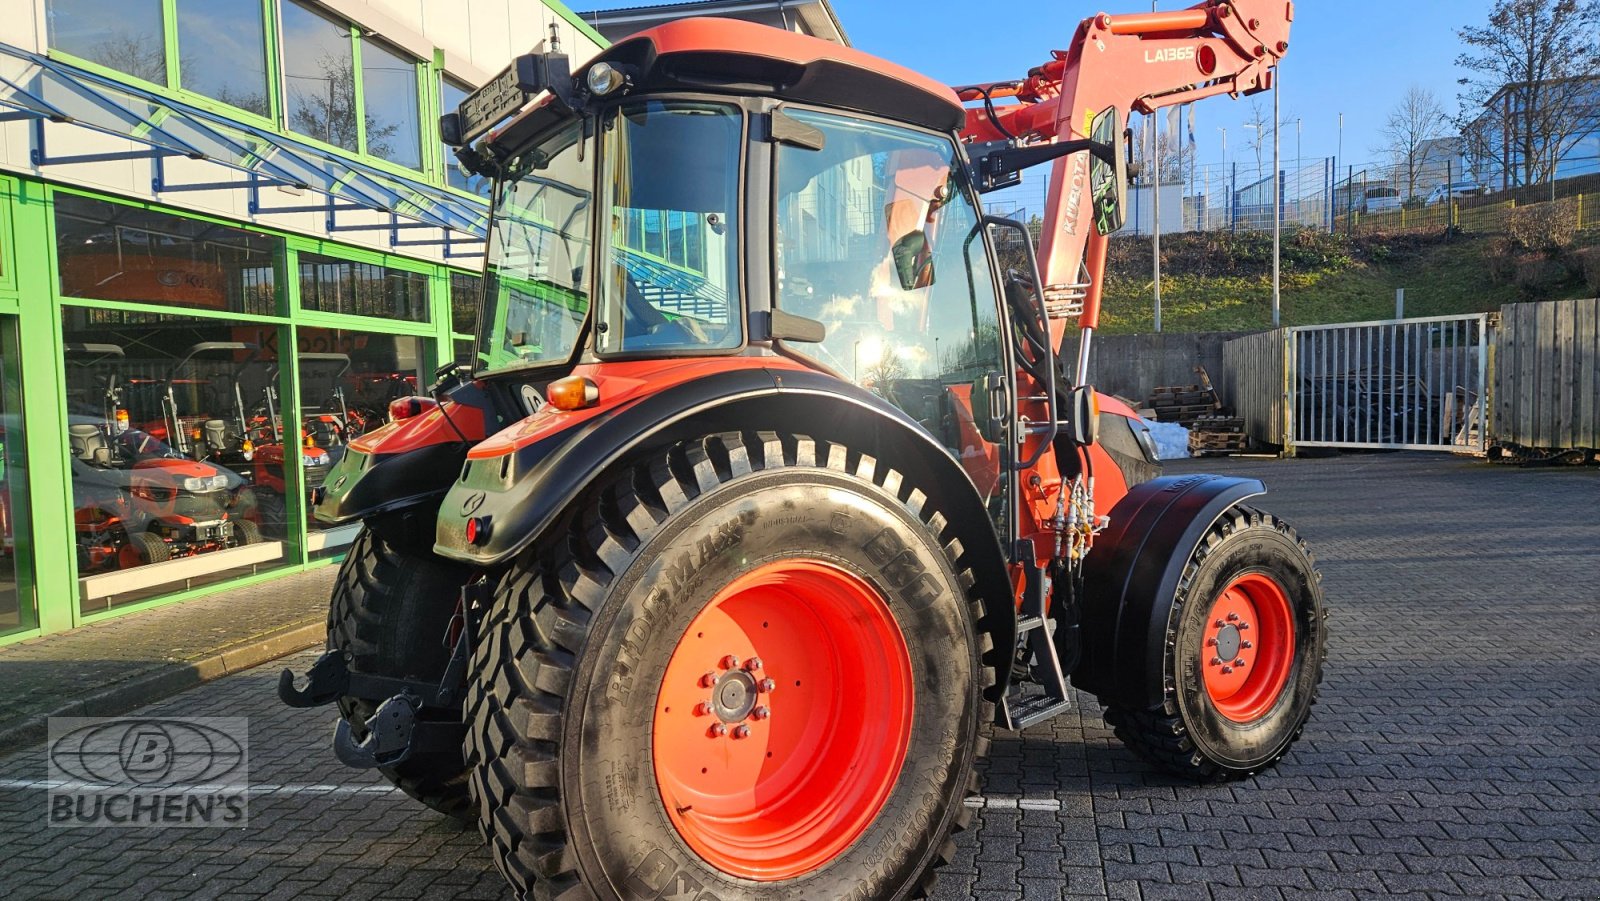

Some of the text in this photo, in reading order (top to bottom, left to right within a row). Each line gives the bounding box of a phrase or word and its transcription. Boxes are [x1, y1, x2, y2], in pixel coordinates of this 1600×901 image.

[1144, 46, 1195, 63] LA1365
[1063, 153, 1089, 235] KUBOTA
[864, 526, 945, 606] BKT
